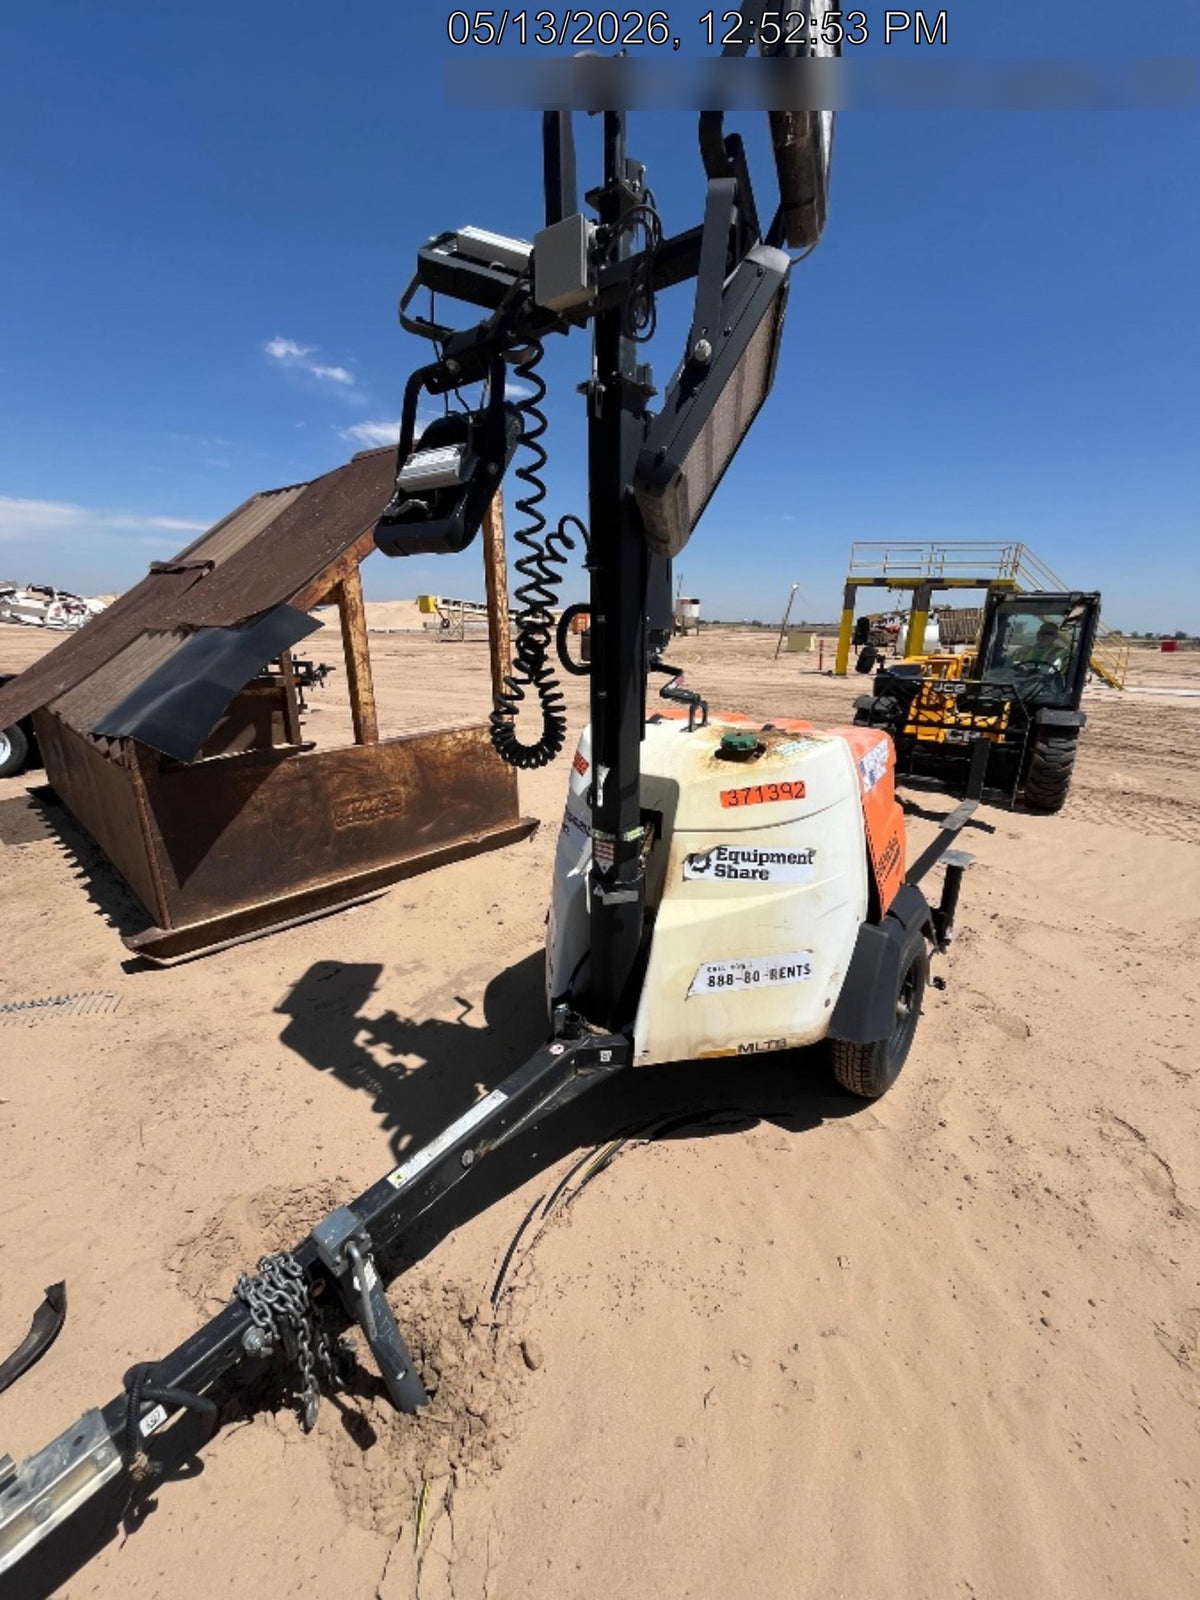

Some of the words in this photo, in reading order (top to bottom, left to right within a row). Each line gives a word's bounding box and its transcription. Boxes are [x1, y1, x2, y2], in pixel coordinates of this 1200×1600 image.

[727, 781, 806, 807] 371392
[715, 847, 815, 867] Equipment
[714, 863, 770, 881] Share
